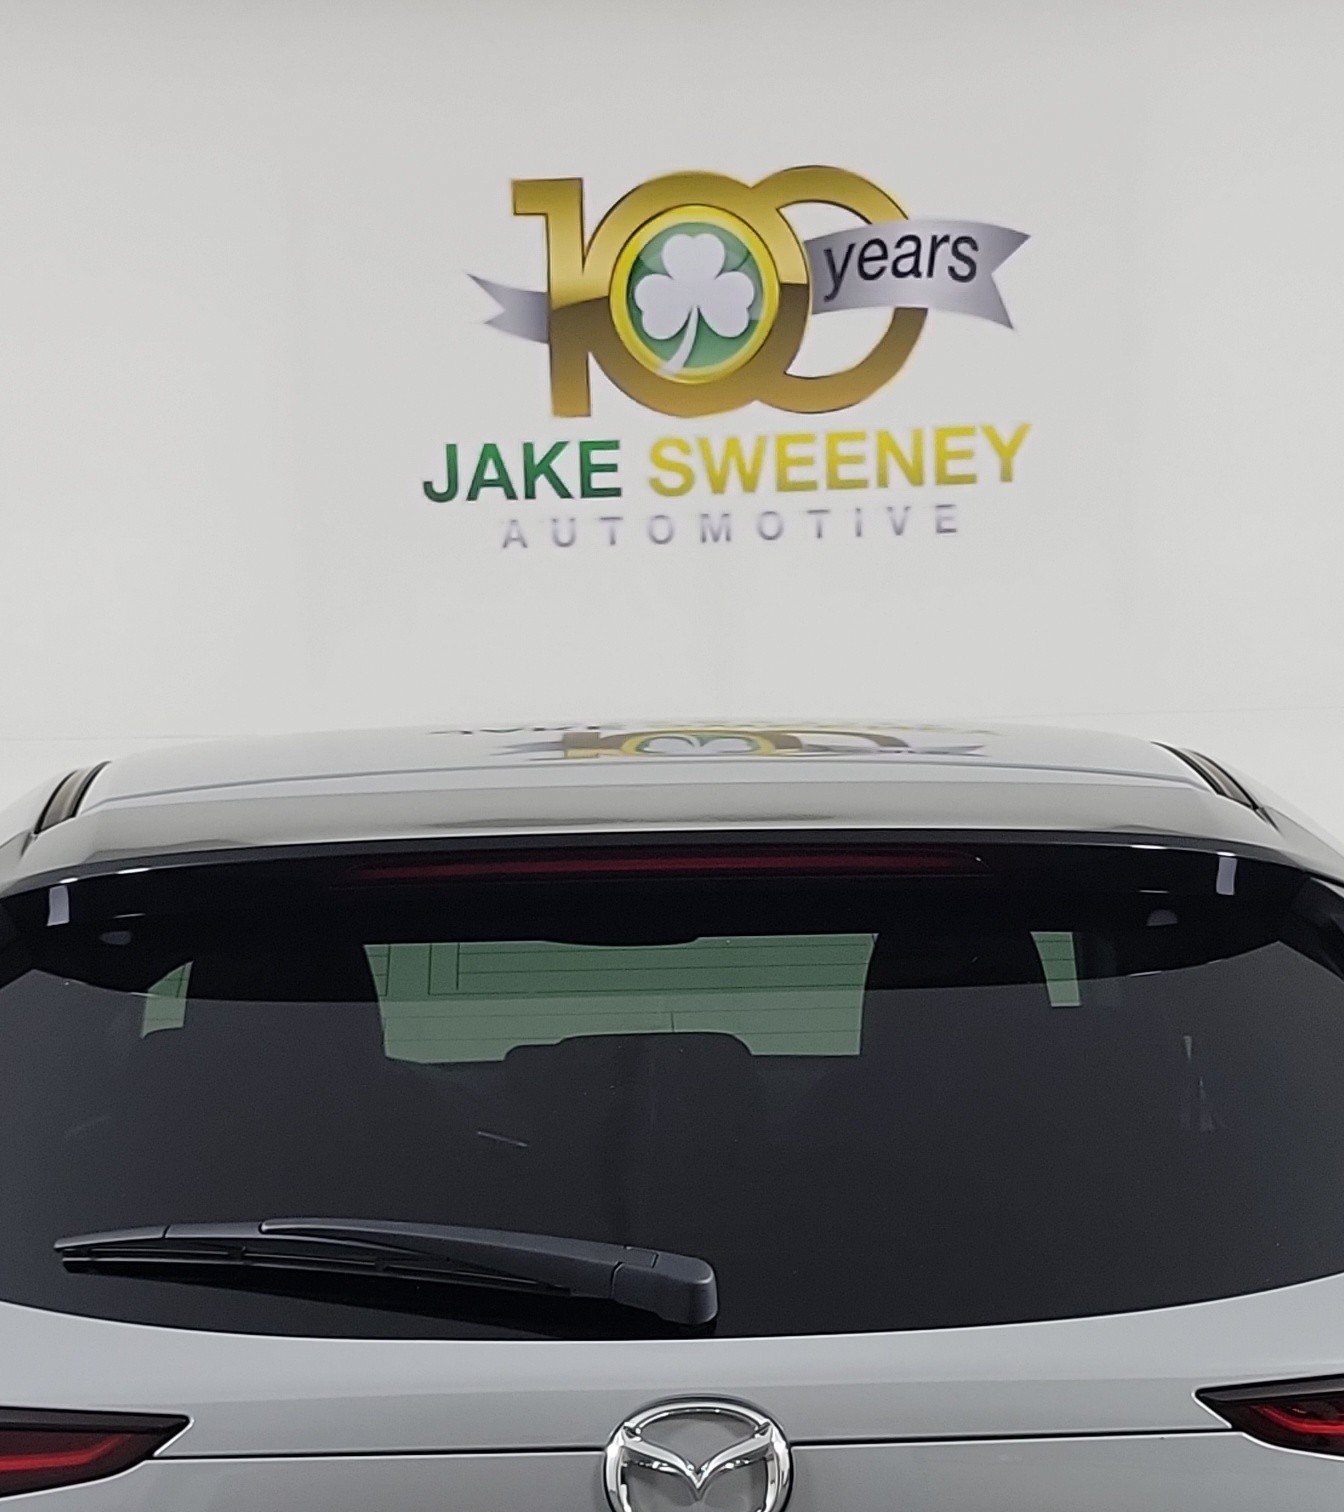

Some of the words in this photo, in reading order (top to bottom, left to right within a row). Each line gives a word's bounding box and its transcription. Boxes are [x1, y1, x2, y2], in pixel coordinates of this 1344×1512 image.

[822, 231, 982, 302] years
[422, 440, 623, 504] JAKE
[647, 423, 1032, 499] SWEENEY
[500, 504, 960, 550] AUTOMOTIVE
